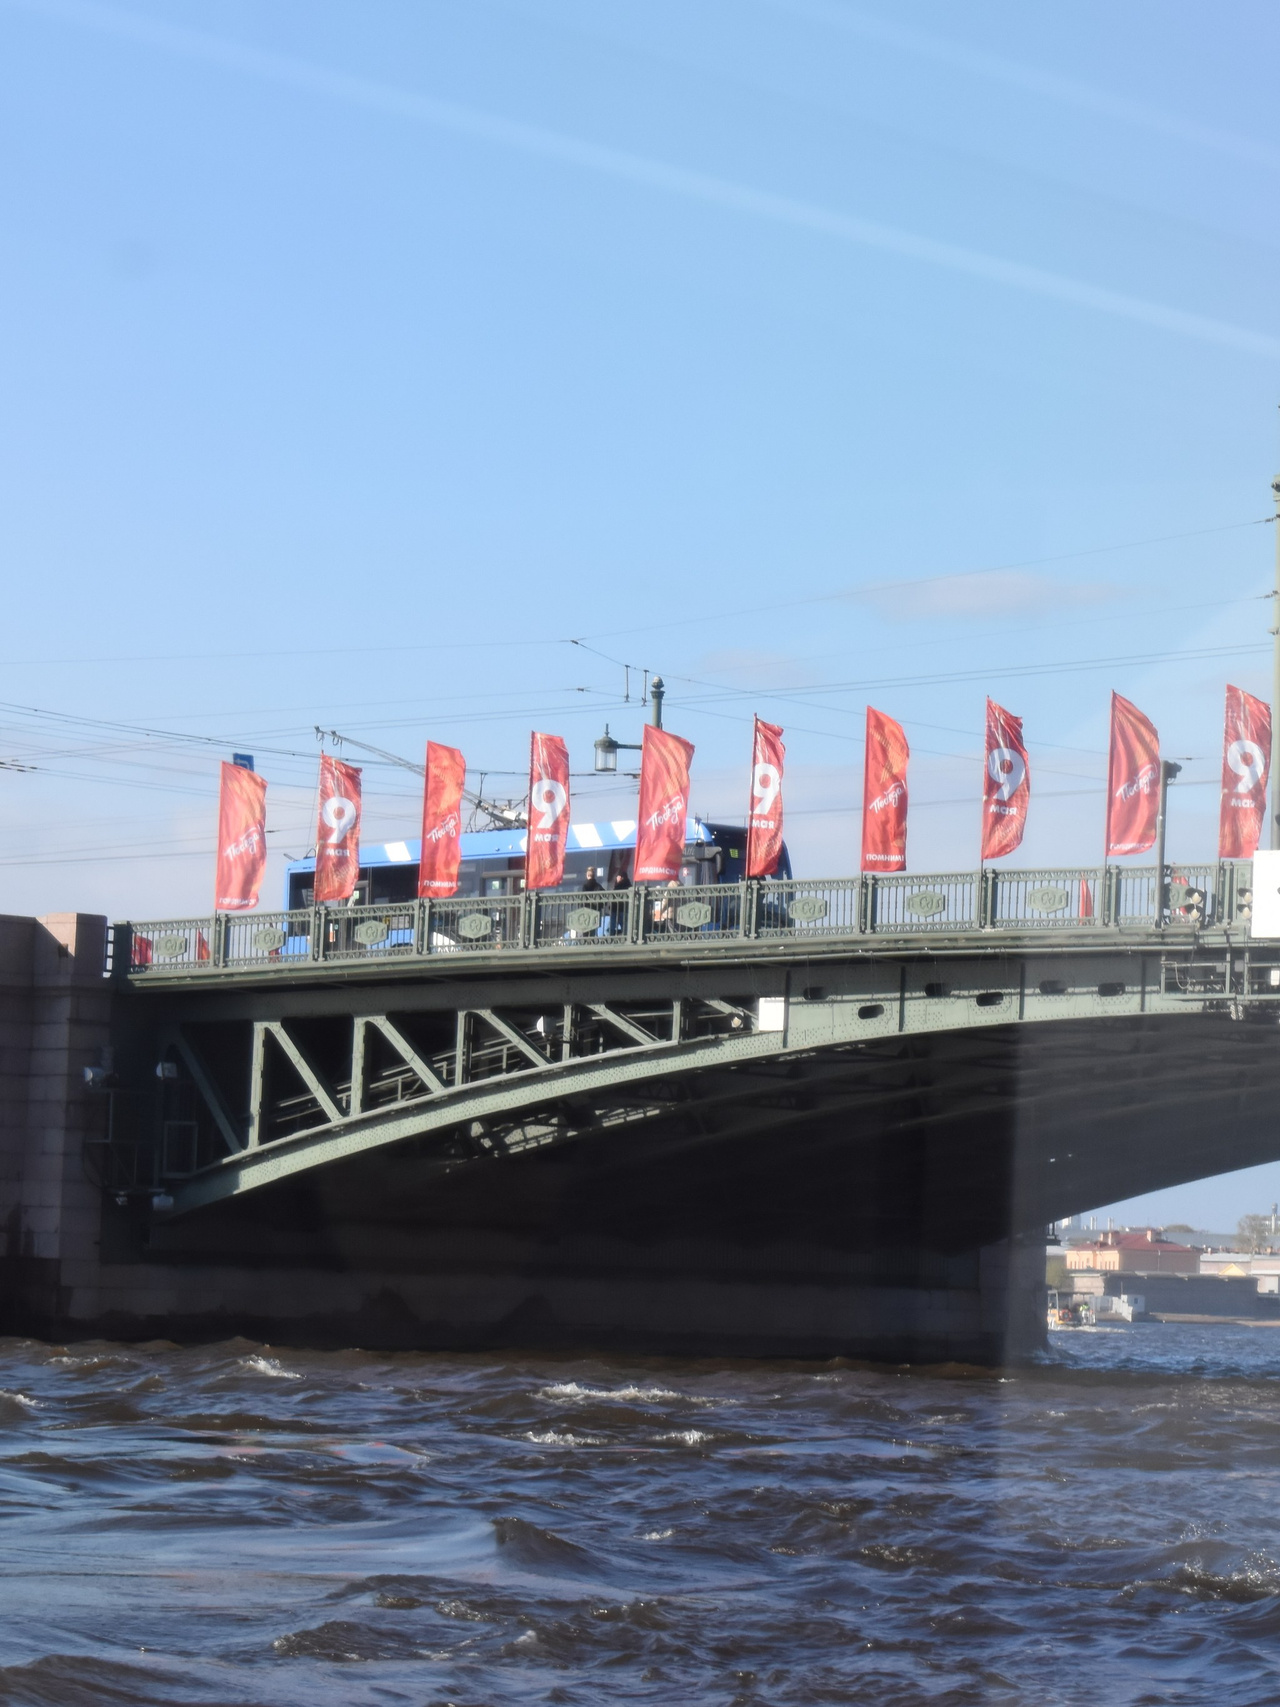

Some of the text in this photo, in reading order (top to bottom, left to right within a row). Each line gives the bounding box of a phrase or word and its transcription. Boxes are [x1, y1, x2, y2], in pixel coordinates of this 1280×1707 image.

[987, 747, 1026, 801] 9
[1227, 739, 1266, 793] 9
[753, 762, 781, 815] 9
[532, 779, 567, 829] 9
[989, 804, 1018, 816] мая
[323, 796, 356, 843] 9
[752, 819, 775, 829] мая
[326, 848, 350, 857] мая
[534, 833, 559, 843] мая
[866, 853, 905, 862] ПОМНИМ!
